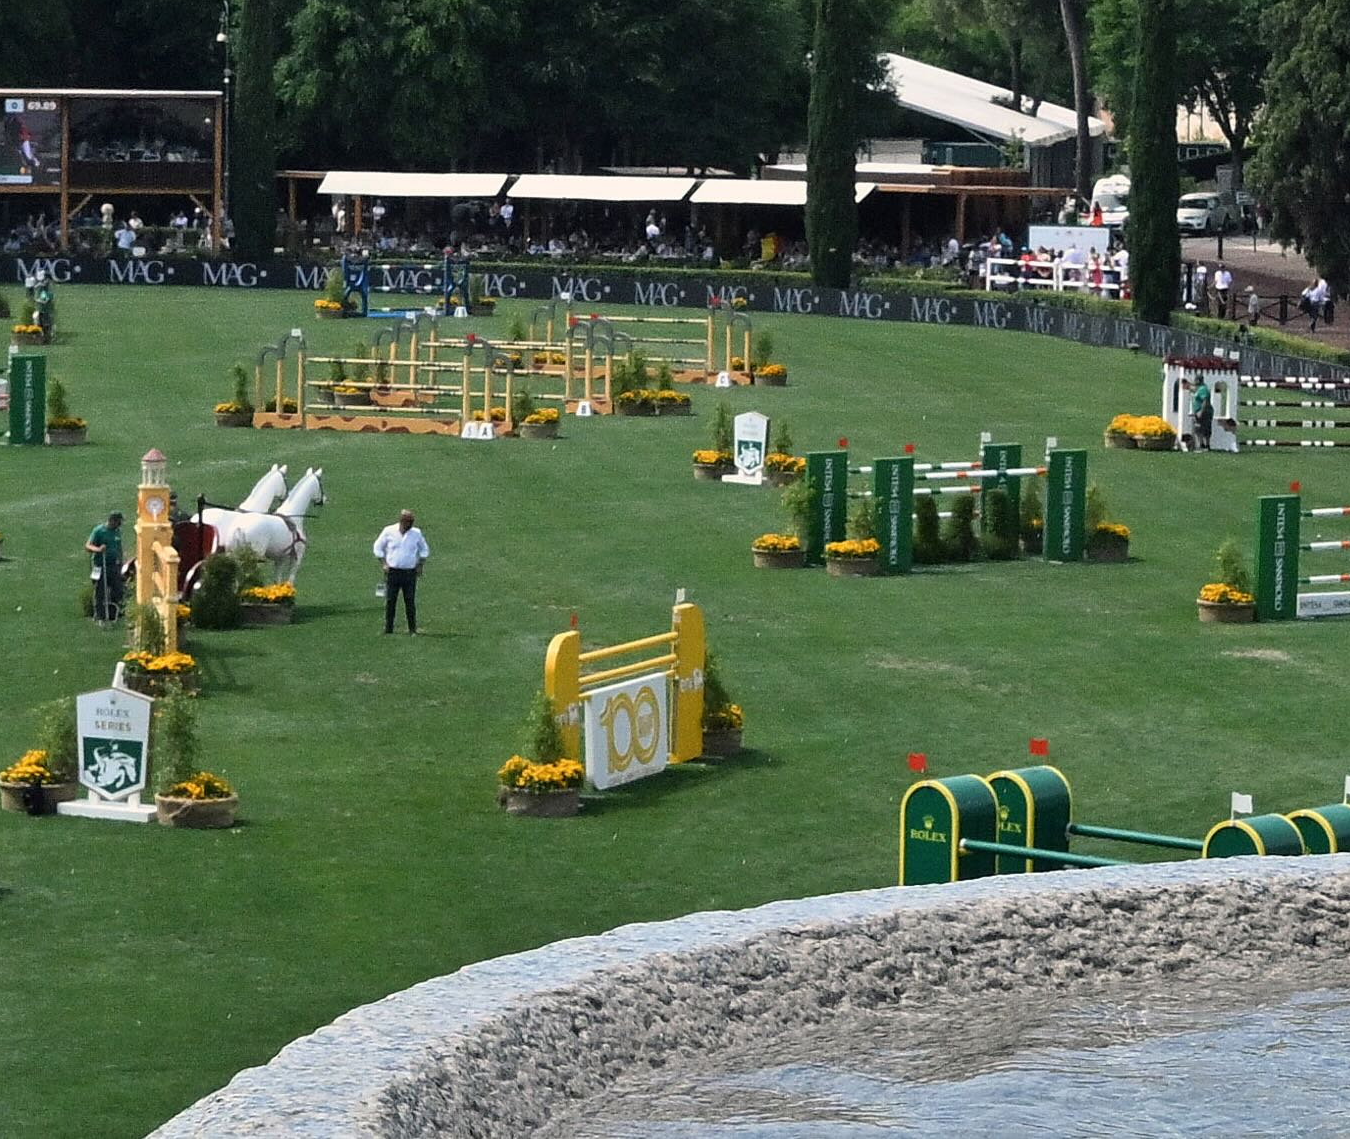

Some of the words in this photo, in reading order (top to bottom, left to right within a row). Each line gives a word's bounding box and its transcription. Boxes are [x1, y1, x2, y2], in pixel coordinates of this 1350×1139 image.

[110, 259, 165, 284] MAG
[202, 261, 258, 287] MAG
[552, 275, 601, 302] MAG
[634, 281, 678, 307] MAG
[773, 286, 812, 313] MAG
[839, 291, 883, 318] MAG
[910, 296, 950, 324] MAG
[94, 720, 131, 732] SERIES
[910, 828, 947, 843] ROLEX
